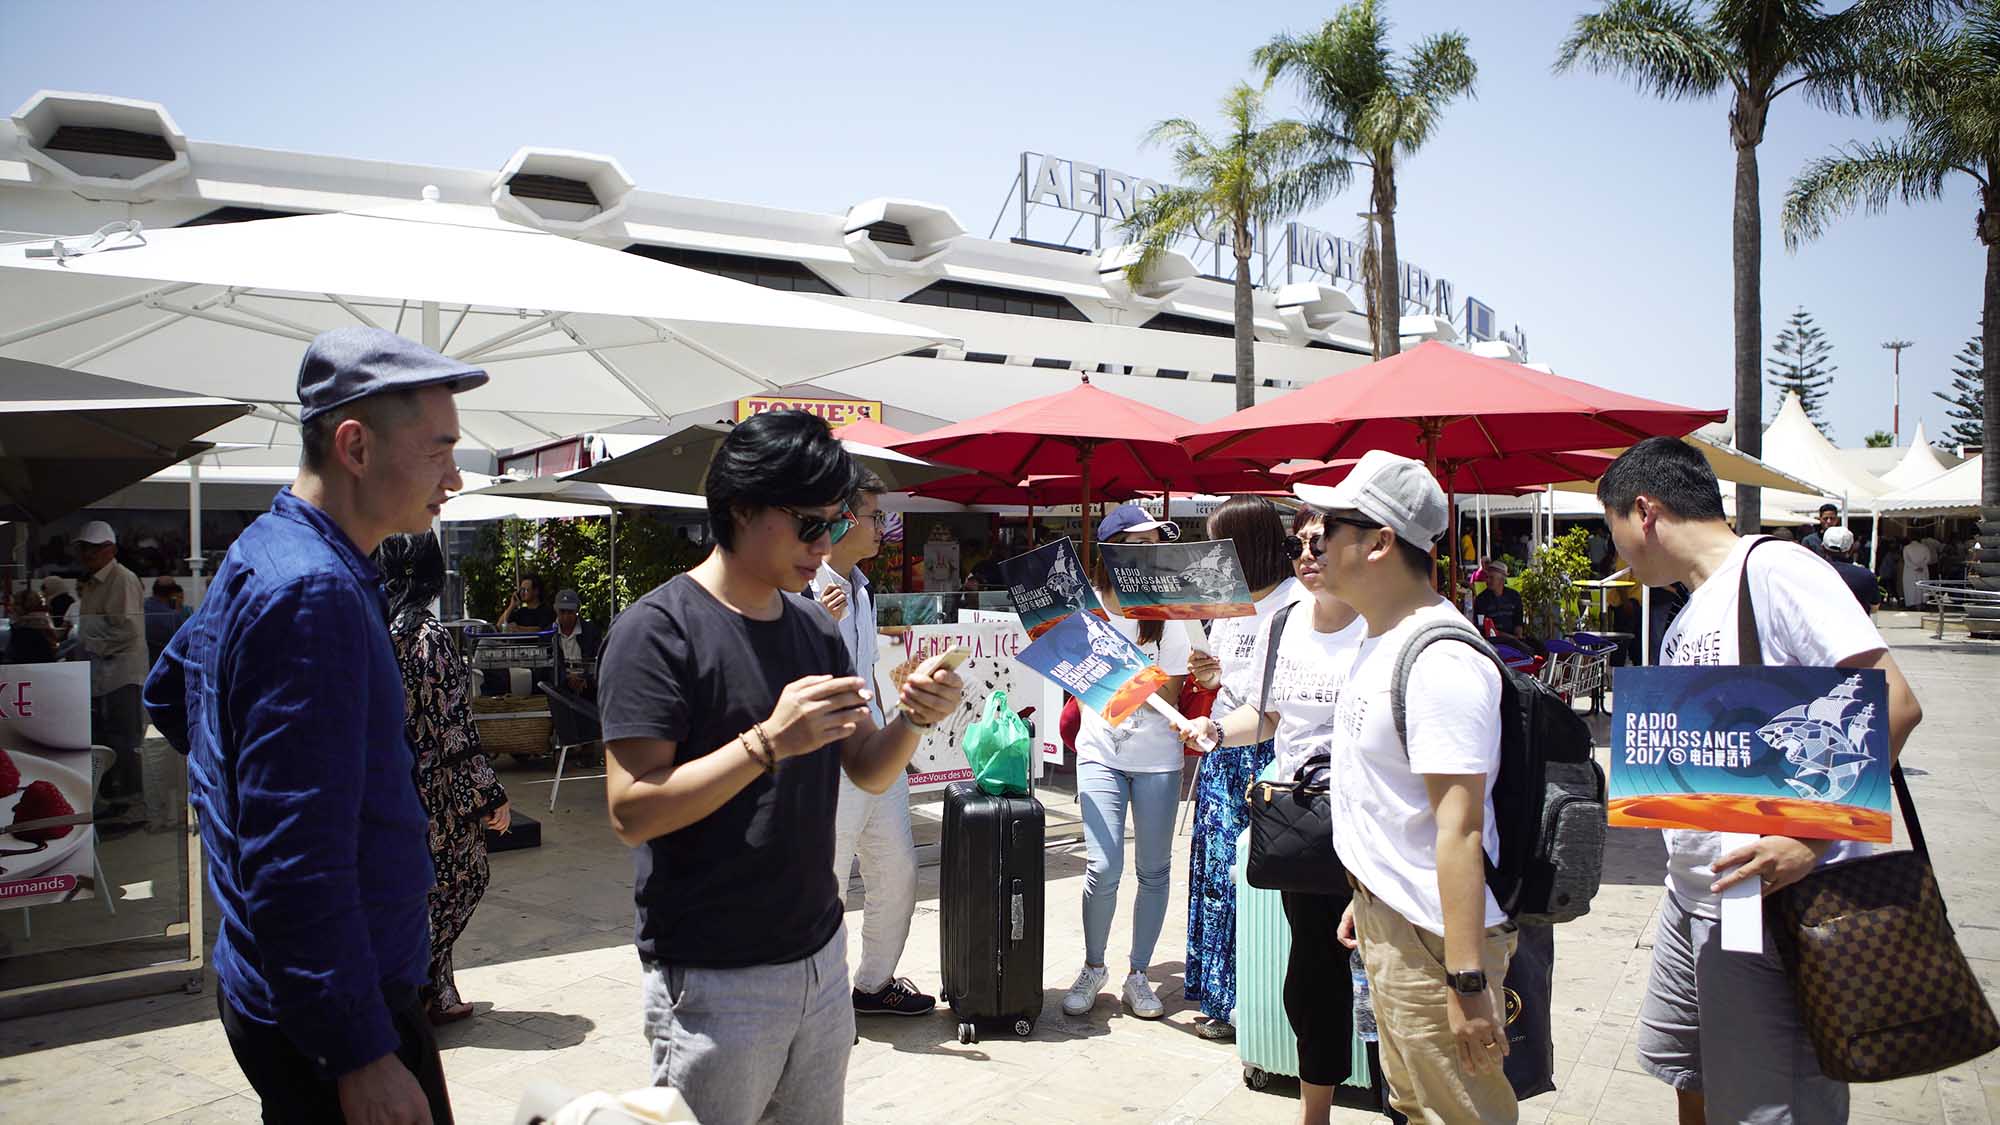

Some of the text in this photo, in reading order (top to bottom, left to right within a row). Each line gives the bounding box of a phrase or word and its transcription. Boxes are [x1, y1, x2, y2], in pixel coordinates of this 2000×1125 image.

[1114, 567, 1140, 577] RADIO
[1117, 576, 1180, 585] RENAISSANCE
[1120, 584, 1139, 593] 2017
[1625, 712, 1677, 730] RADIO
[1625, 730, 1751, 750] RENAISSANCE
[1625, 748, 1665, 765] 2017
[948, 769, 961, 779] des
